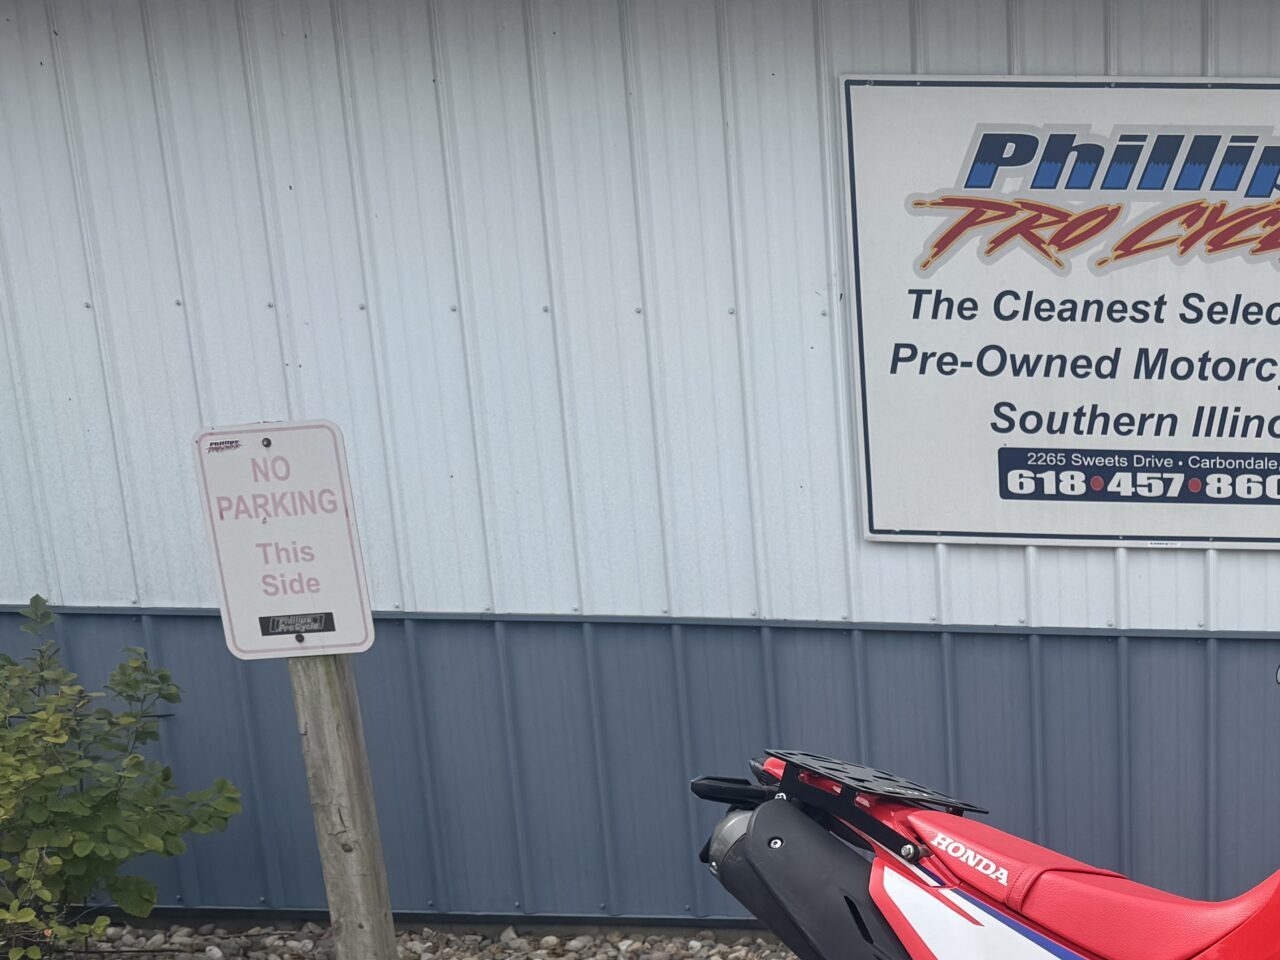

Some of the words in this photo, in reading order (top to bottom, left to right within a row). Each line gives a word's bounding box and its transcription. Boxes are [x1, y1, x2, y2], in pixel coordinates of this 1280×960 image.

[914, 196, 1123, 270] PRO
[907, 289, 979, 321] The
[992, 290, 1165, 324] Cleanest
[889, 343, 1121, 379] Pre-Owned
[990, 402, 1178, 437] Southern
[251, 455, 291, 482] NO
[1027, 452, 1066, 465] 2265
[1071, 453, 1128, 467] Sweets
[1133, 455, 1173, 468] Drive
[1007, 469, 1086, 495] 618
[1107, 471, 1185, 497] 457
[216, 488, 338, 521] PARKING
[255, 541, 316, 565] This
[261, 572, 321, 597] Side
[929, 832, 1009, 887] HONDA
